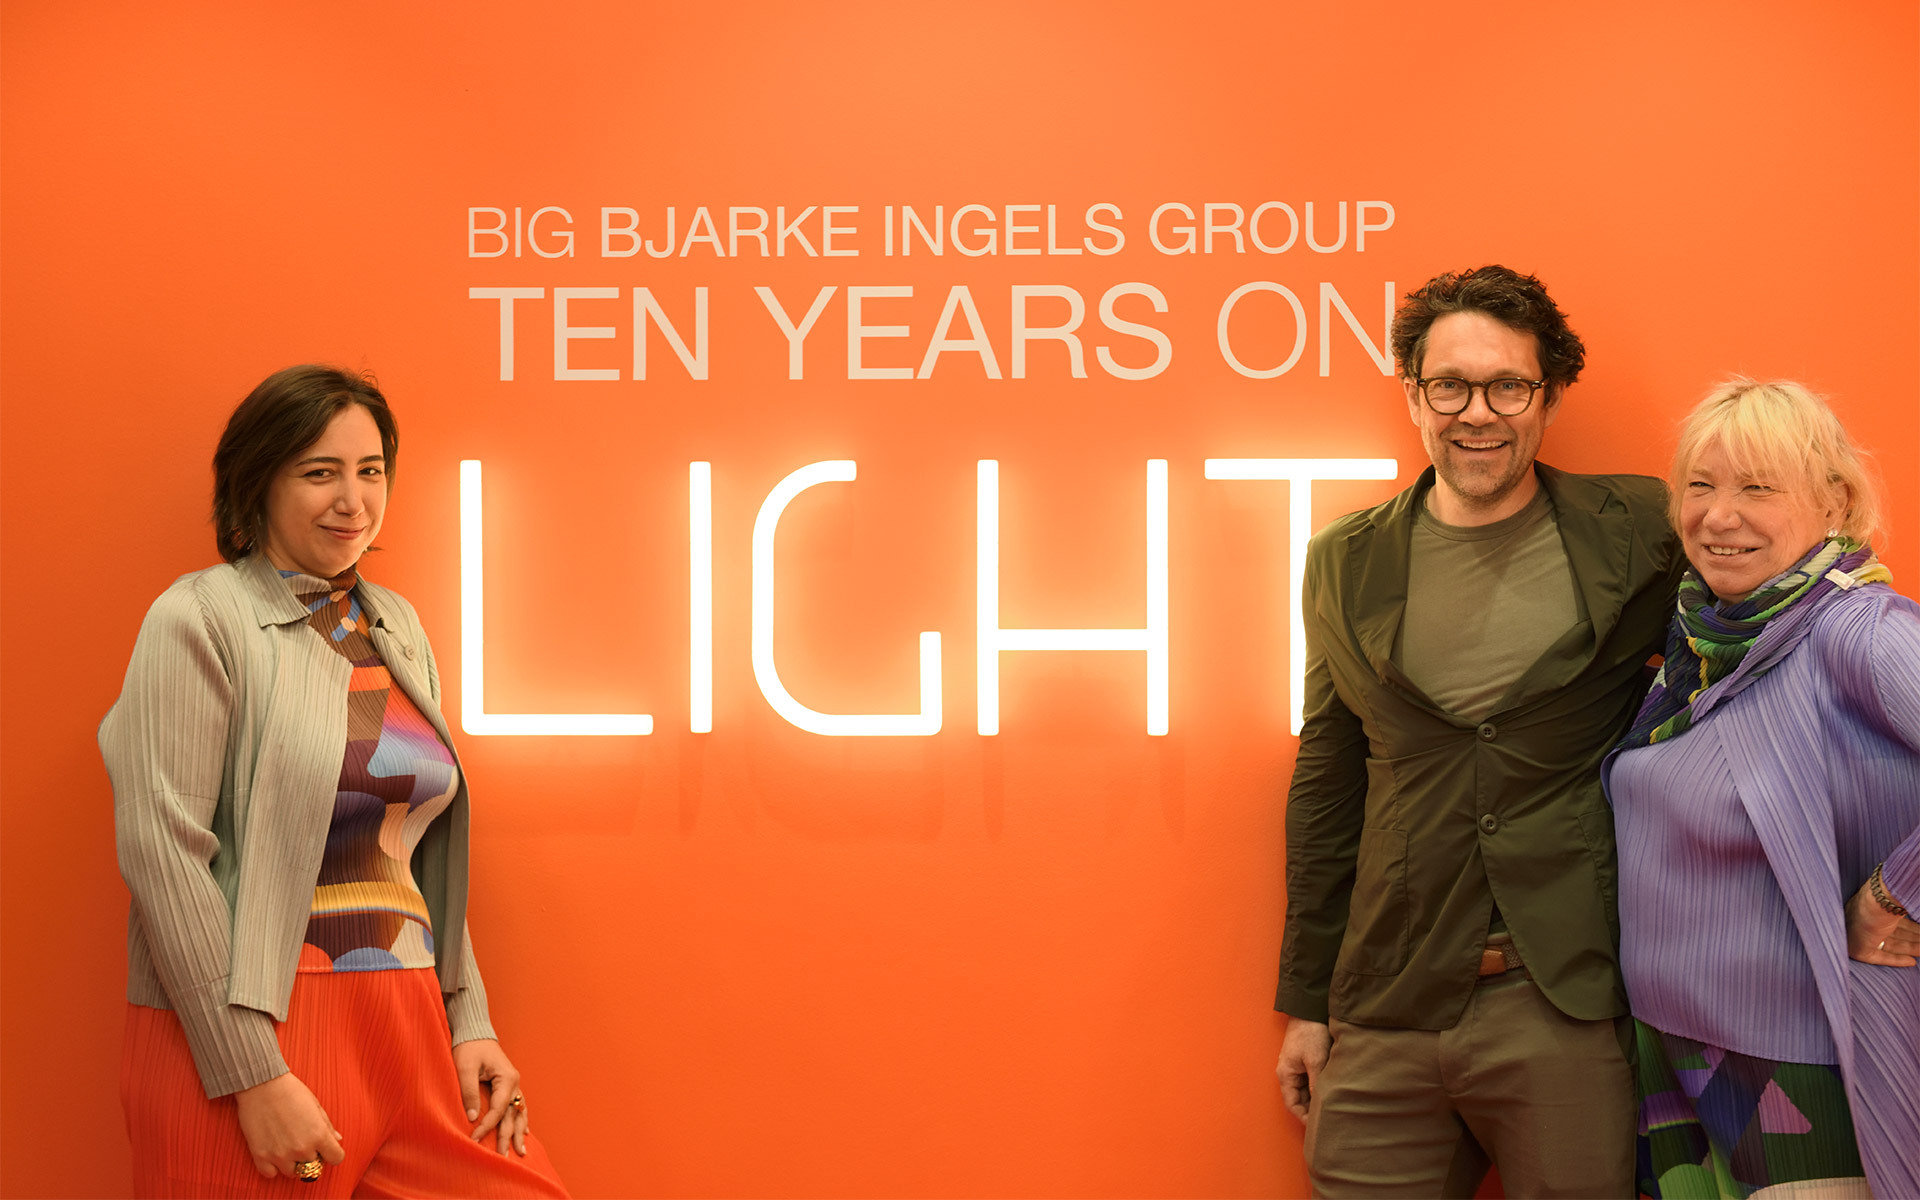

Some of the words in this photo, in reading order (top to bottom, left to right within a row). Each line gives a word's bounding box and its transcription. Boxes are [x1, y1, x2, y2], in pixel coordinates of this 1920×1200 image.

[468, 206, 574, 258] BIG
[600, 205, 859, 258] BJARKE
[884, 202, 1125, 256] INGELS
[1148, 200, 1396, 255] GROUP
[468, 286, 708, 381] TEN
[753, 281, 1172, 380] YEARS
[1216, 280, 1396, 379] ON
[459, 458, 1398, 737] LIGHT
